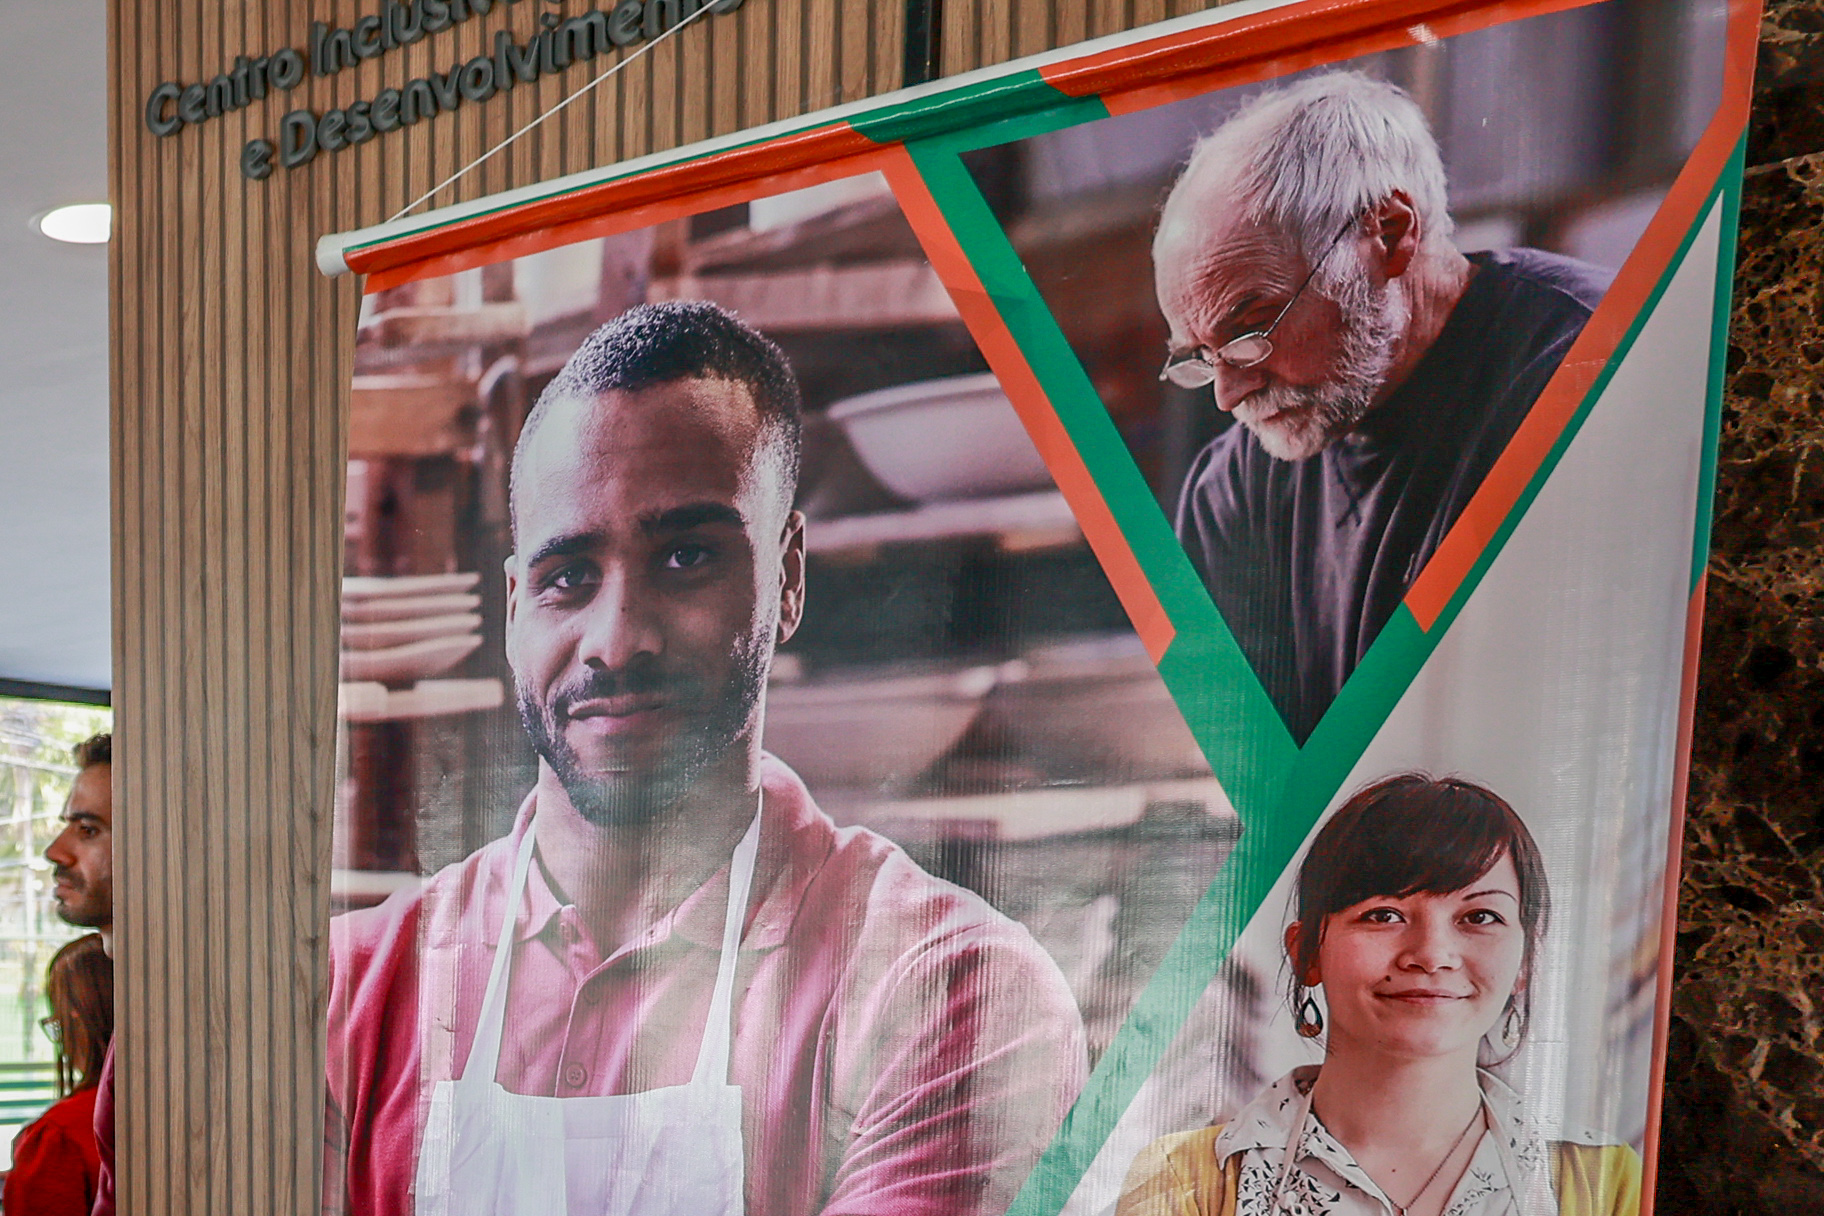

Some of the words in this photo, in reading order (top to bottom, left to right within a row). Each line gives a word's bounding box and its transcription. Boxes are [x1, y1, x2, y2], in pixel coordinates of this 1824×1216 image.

[145, 47, 304, 137] Centro
[311, 0, 522, 77] Inclus
[240, 139, 275, 180] e
